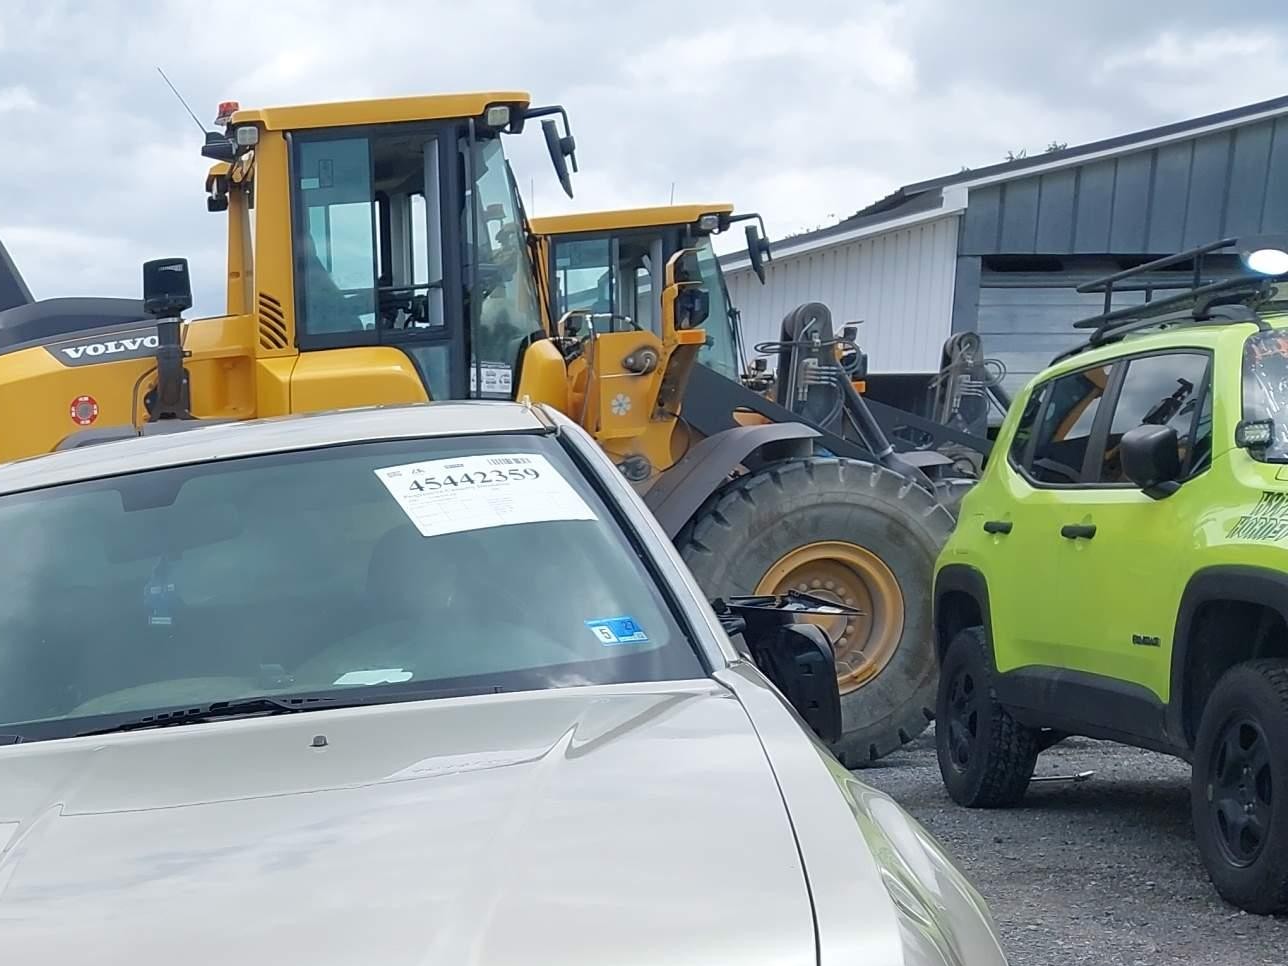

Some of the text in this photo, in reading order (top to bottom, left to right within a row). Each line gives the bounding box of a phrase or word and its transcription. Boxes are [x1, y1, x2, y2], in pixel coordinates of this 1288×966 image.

[61, 335, 159, 359] VOLVO
[409, 468, 540, 492] 45442359
[599, 628, 612, 640] 5
